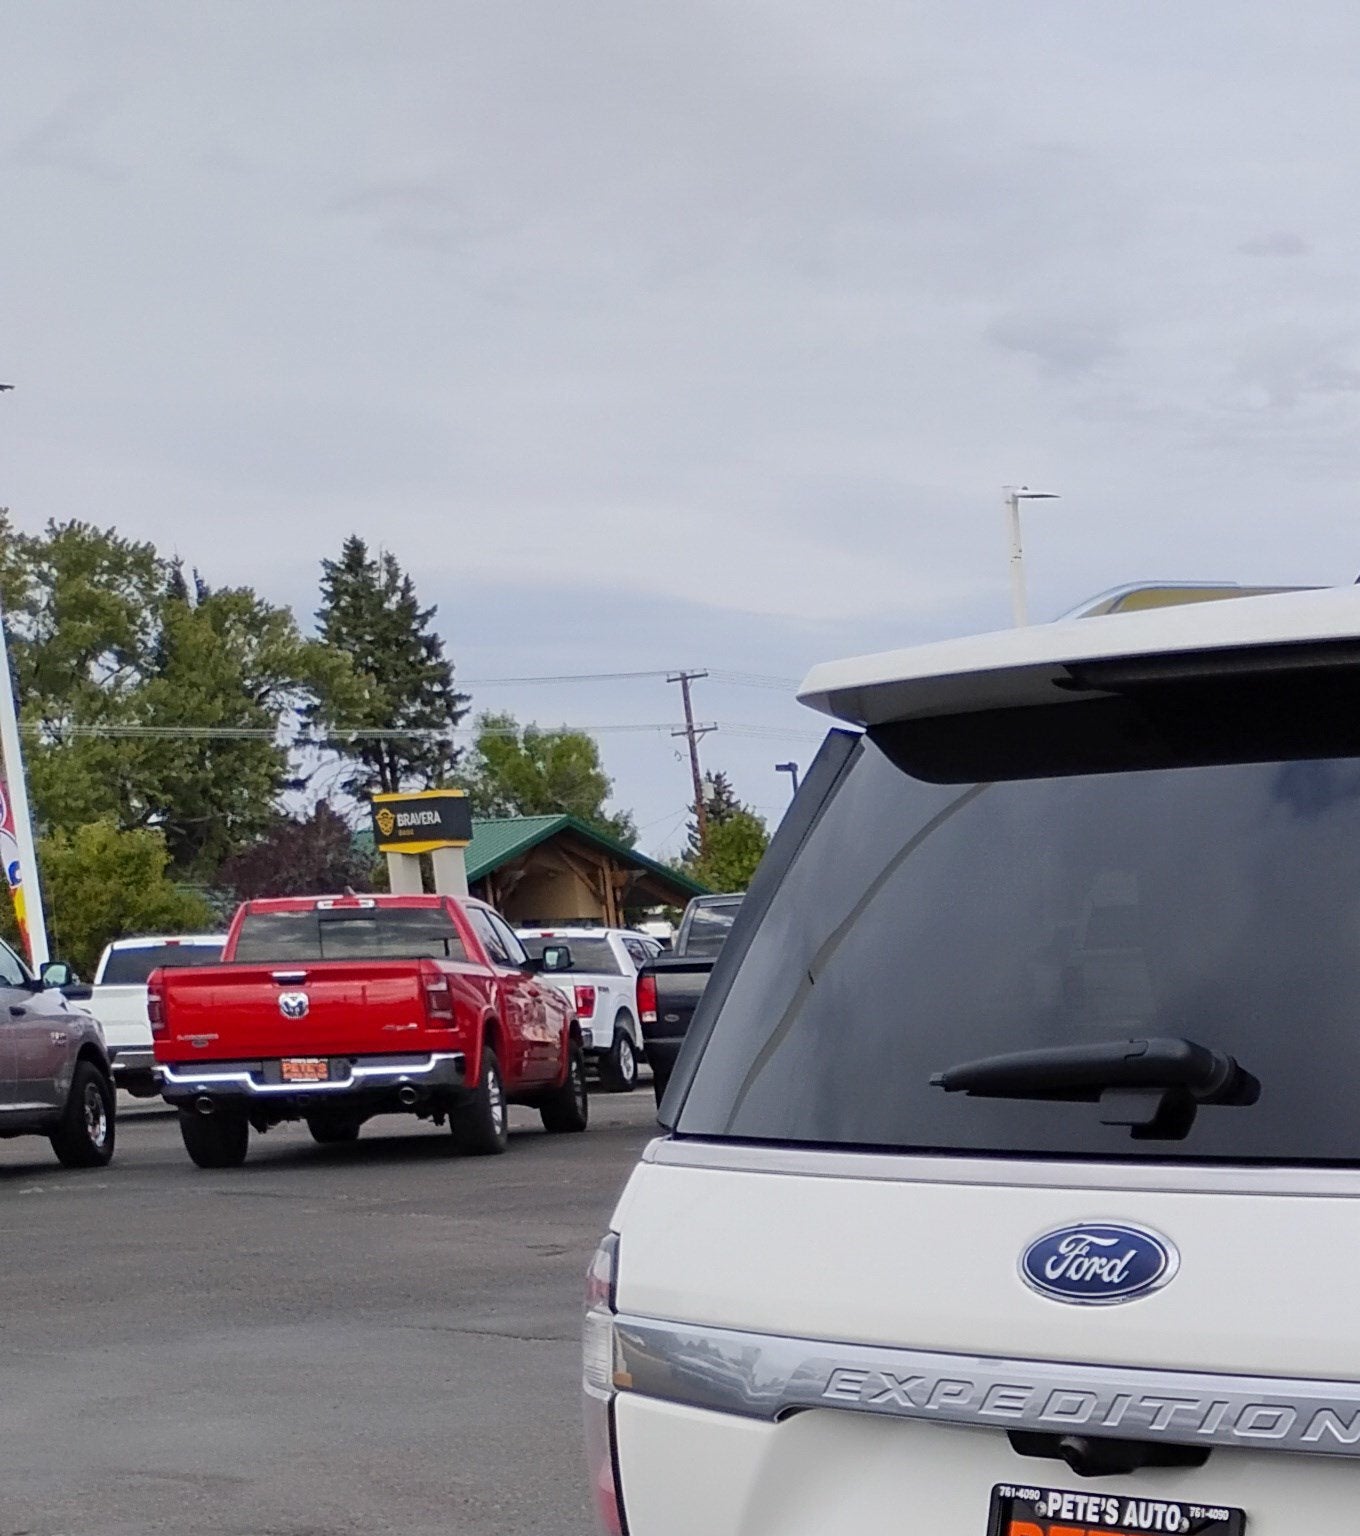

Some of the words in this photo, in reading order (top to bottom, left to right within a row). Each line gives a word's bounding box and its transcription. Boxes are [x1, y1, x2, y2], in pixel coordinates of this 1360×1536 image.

[396, 811, 441, 827] BRAVERA
[1045, 1234, 1138, 1283] Ford
[999, 1485, 1040, 1501] 761-4090
[1047, 1491, 1119, 1525] PETE'S
[1123, 1500, 1180, 1532] AUTO
[1189, 1506, 1229, 1521] 761-4090
